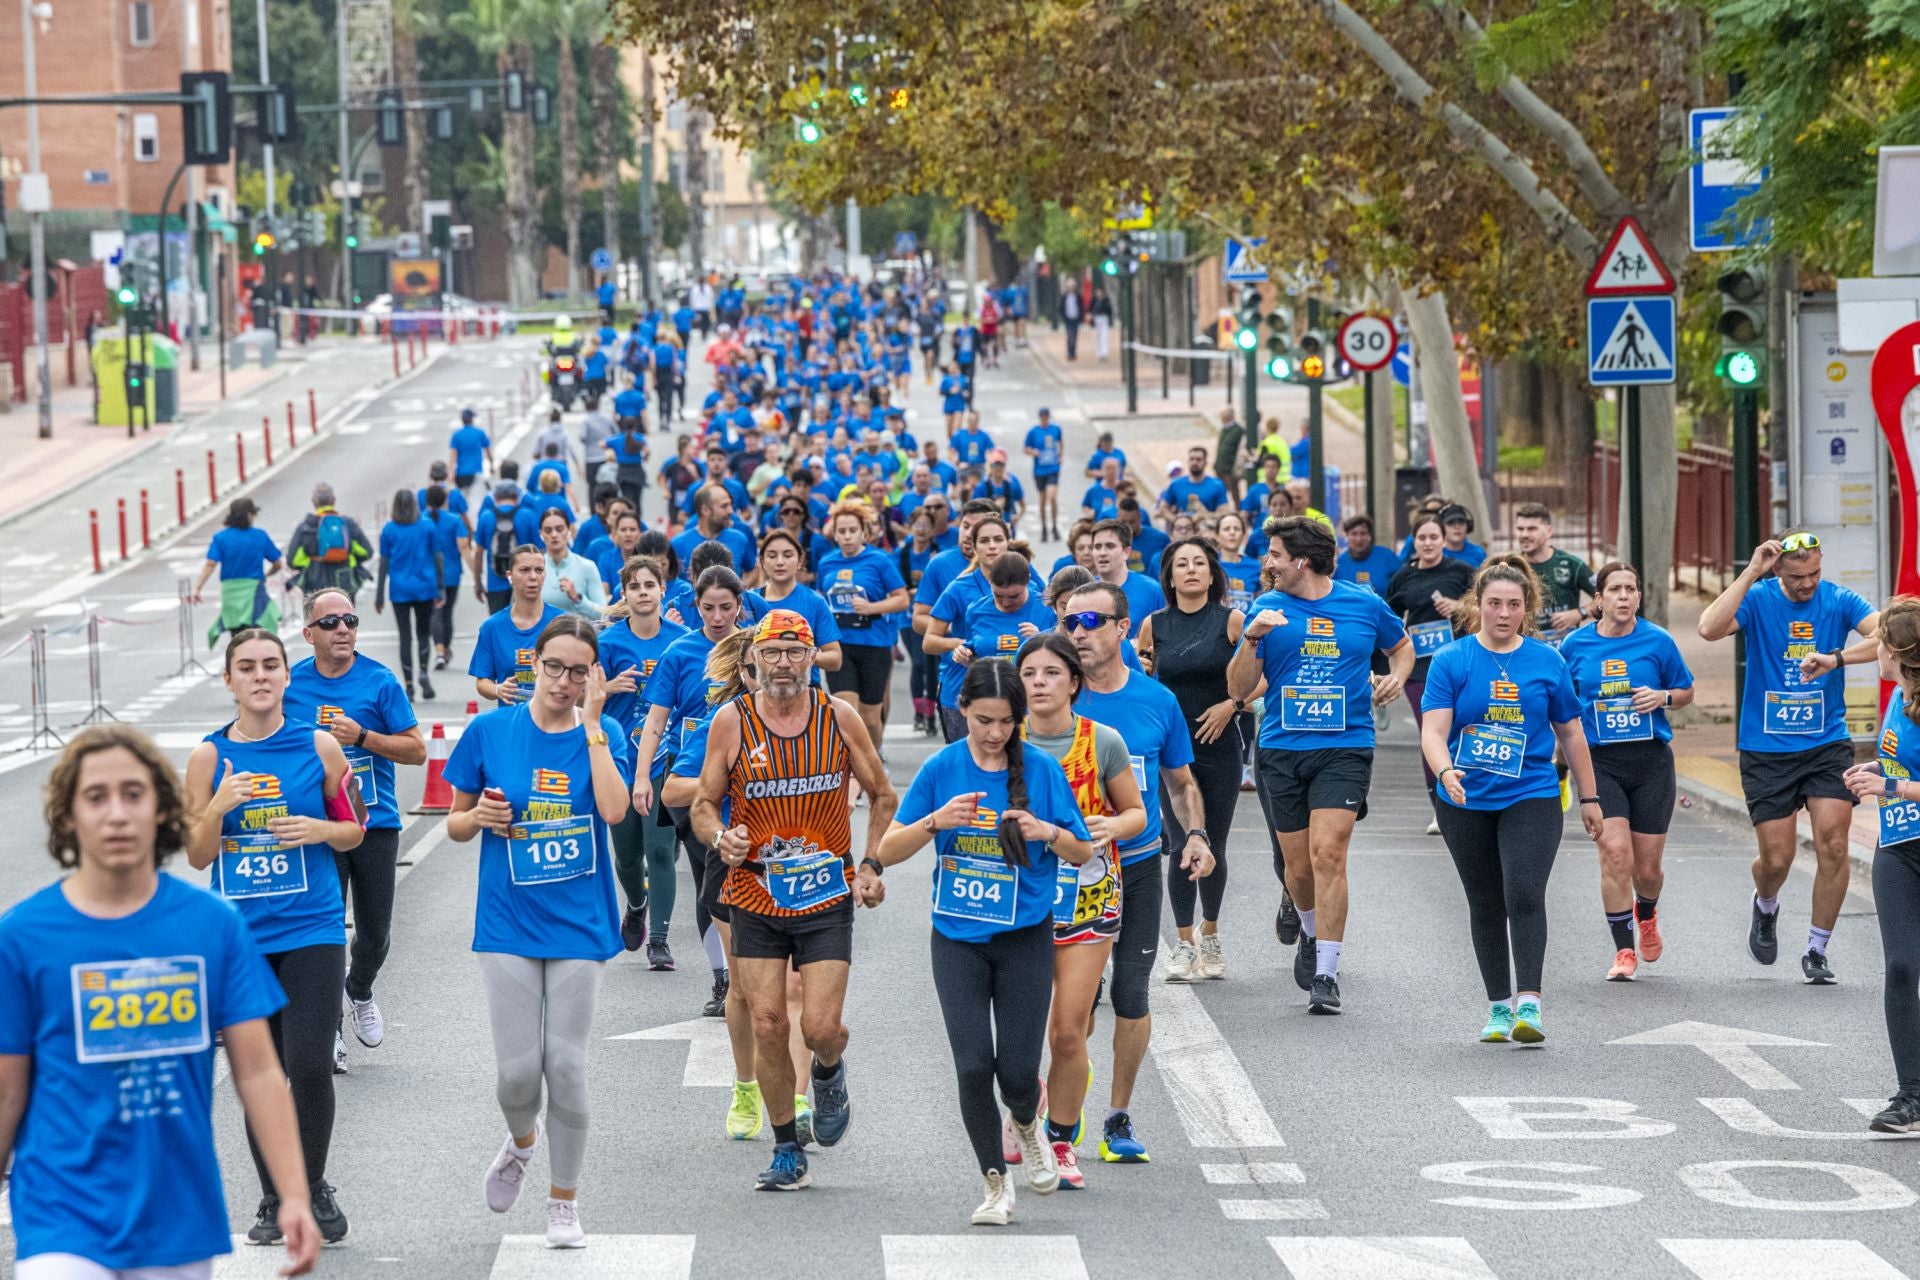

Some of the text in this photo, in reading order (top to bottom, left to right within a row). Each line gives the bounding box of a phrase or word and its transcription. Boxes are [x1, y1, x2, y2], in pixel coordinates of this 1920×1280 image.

[1351, 332, 1385, 351] 30
[1418, 631, 1445, 647] 371
[1307, 647, 1340, 657] VALENCIA
[1294, 701, 1333, 716] 744
[1776, 706, 1813, 721] 473
[1490, 713, 1525, 722] VALENCIA
[1606, 713, 1641, 728] 596
[1471, 739, 1511, 760] 348
[745, 771, 843, 800] CORREBIRRAS
[528, 800, 572, 814] MUÉVETE
[1885, 802, 1920, 828] 925
[957, 834, 999, 847] MUÉVETE
[527, 838, 580, 864] 103
[961, 844, 1004, 857] VALENCIA
[235, 854, 289, 878] 436
[783, 867, 831, 895] 726
[952, 877, 1002, 904] 504
[89, 988, 197, 1031] 2826
